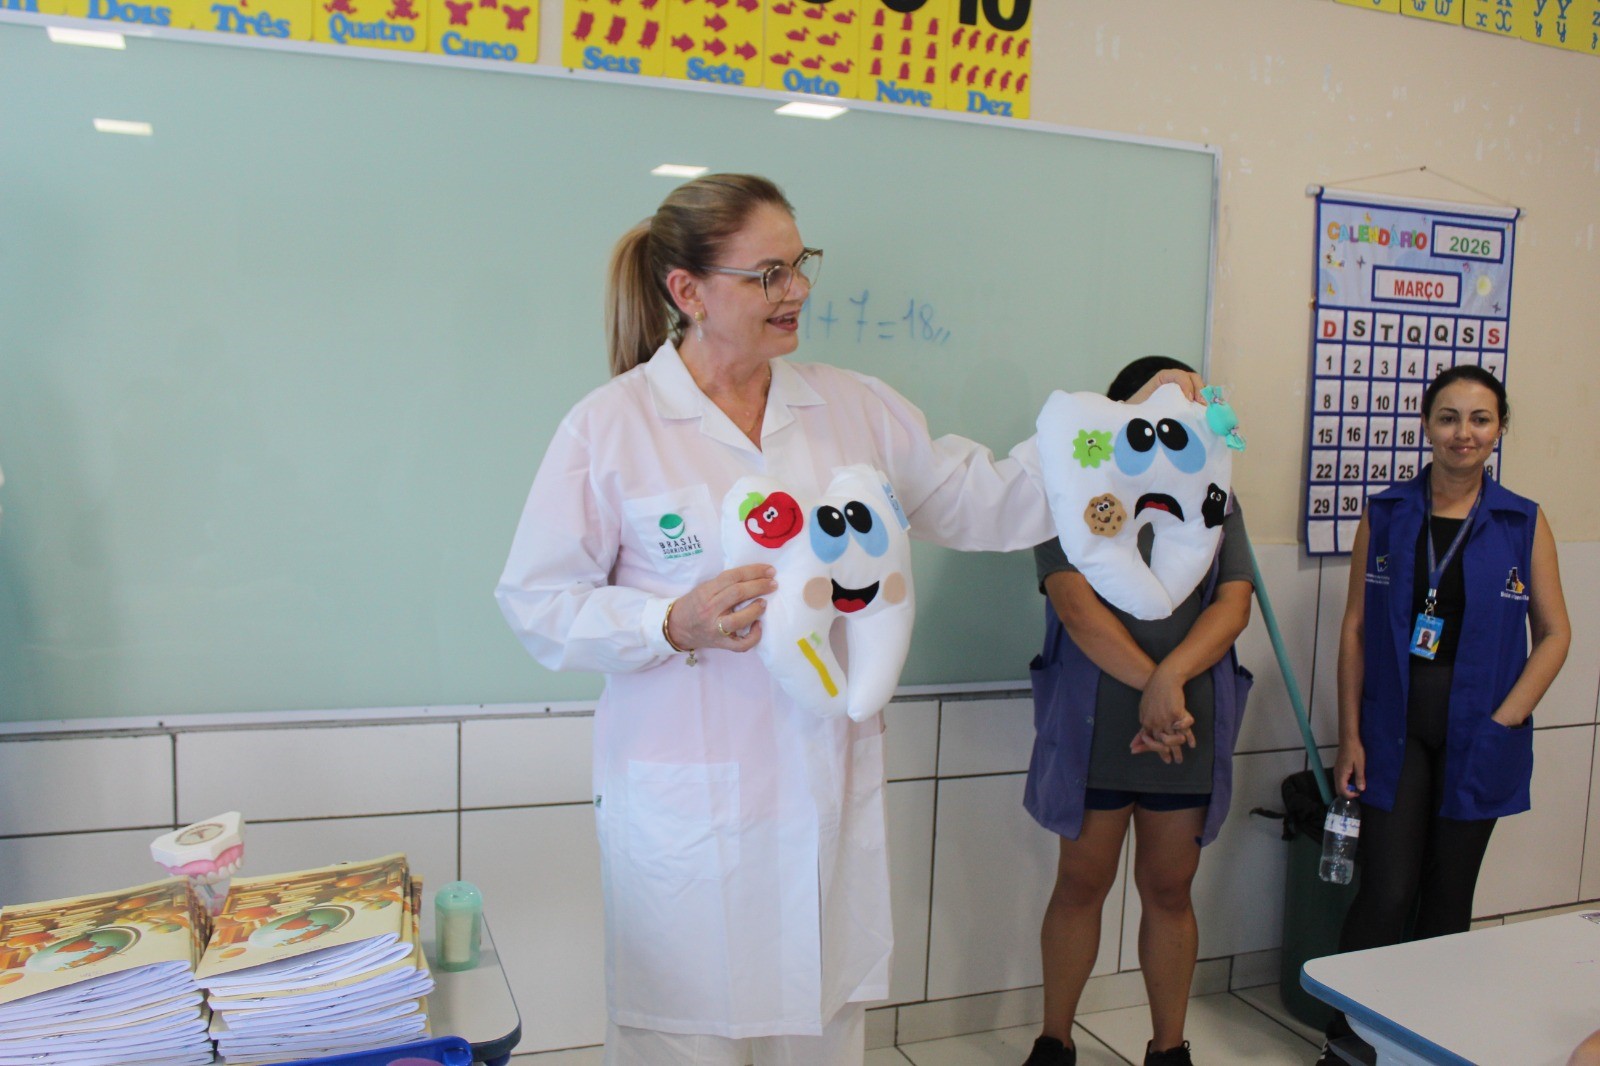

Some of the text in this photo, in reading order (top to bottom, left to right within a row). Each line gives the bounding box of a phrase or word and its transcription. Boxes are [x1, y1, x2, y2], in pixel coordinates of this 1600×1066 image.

[211, 4, 291, 38] Três
[329, 13, 416, 44] Quatro
[441, 31, 518, 61] Cinco
[583, 46, 642, 75] Seis
[686, 57, 745, 85] Sete
[875, 79, 933, 108] Nove
[966, 90, 1013, 118] Dez
[1327, 221, 1428, 250] CALENDÁRIO
[1449, 236, 1492, 256] 2026
[1393, 279, 1444, 301] MARÇO
[1323, 319, 1500, 345] D S T Q Q S S
[1325, 355, 1333, 371] 1
[1353, 359, 1361, 374] 2
[1381, 360, 1389, 375] 3
[1408, 361, 1416, 376] 4
[1323, 395, 1418, 411] 8 9 10 11
[1318, 427, 1415, 445] 15 16 17 18
[1316, 464, 1332, 479] 22
[1344, 464, 1360, 479] 23
[1371, 464, 1387, 479] 24
[1398, 464, 1414, 479] 25
[1313, 496, 1358, 514] 29 30
[659, 535, 700, 549] BRASIL
[663, 543, 701, 554] SORRIDENTE
